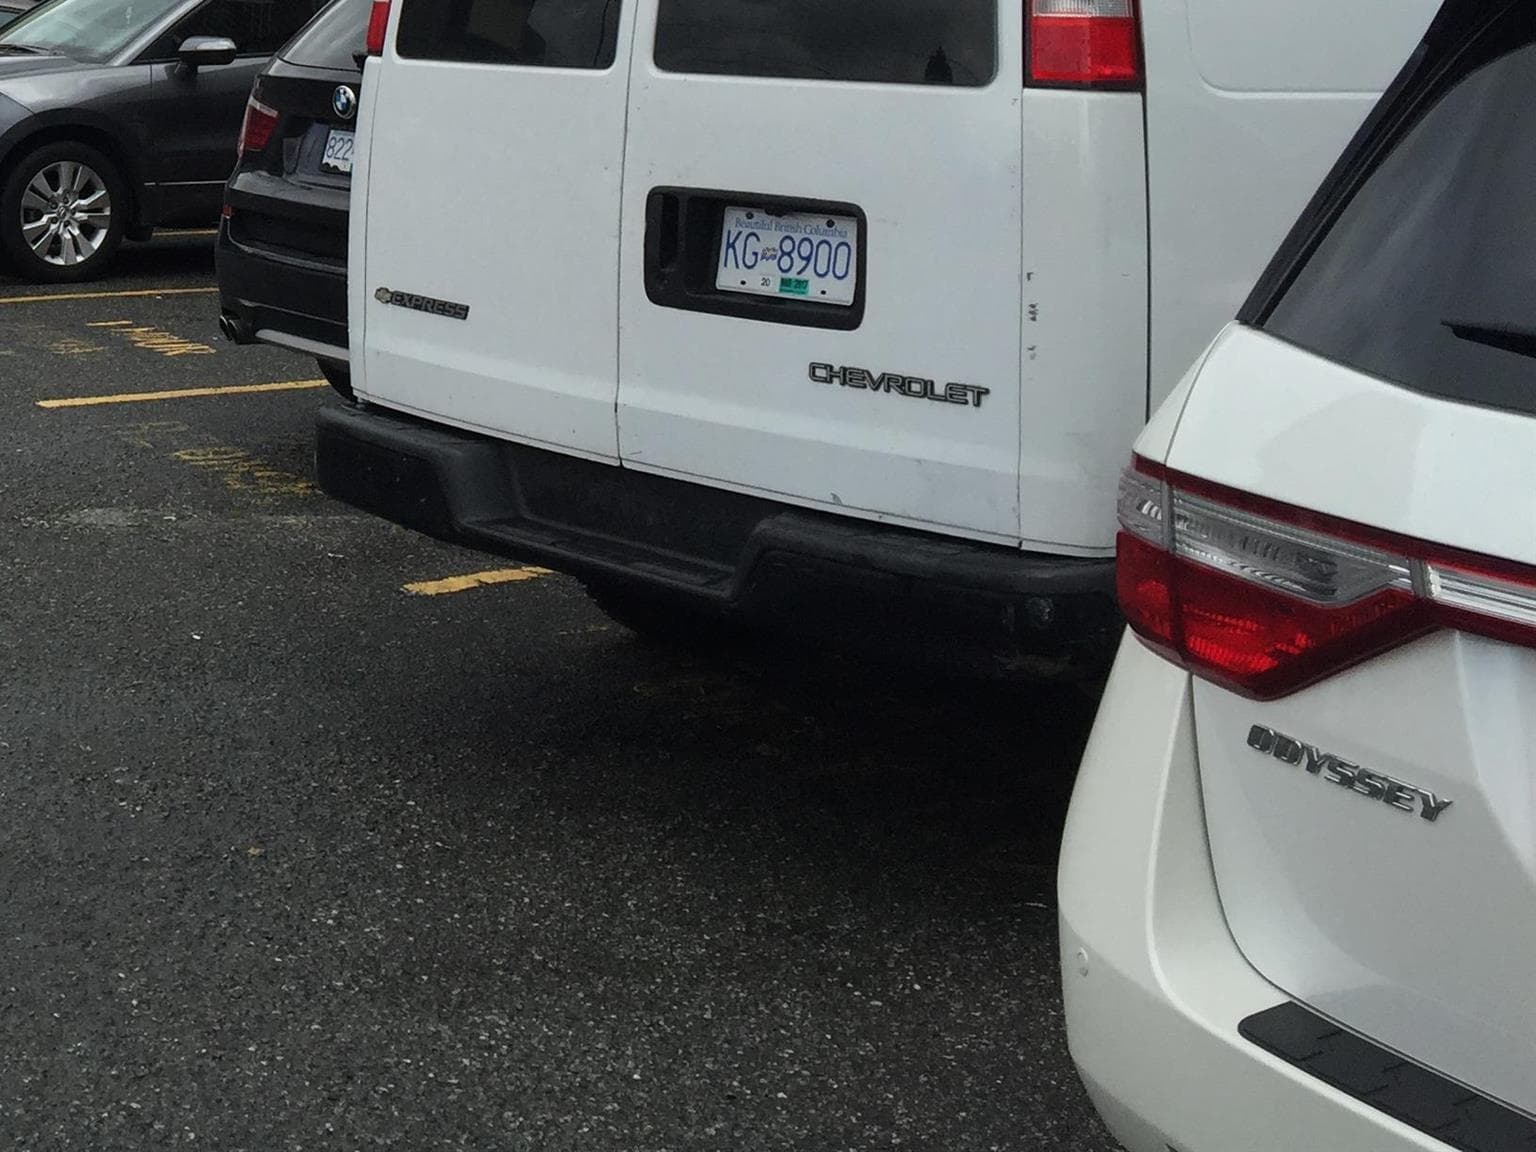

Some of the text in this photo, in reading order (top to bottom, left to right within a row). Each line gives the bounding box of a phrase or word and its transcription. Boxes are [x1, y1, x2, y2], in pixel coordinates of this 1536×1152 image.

[391, 290, 470, 320] EXPRESS
[809, 362, 990, 407] CHEVROLET
[1247, 724, 1453, 823] ODYSSEY
